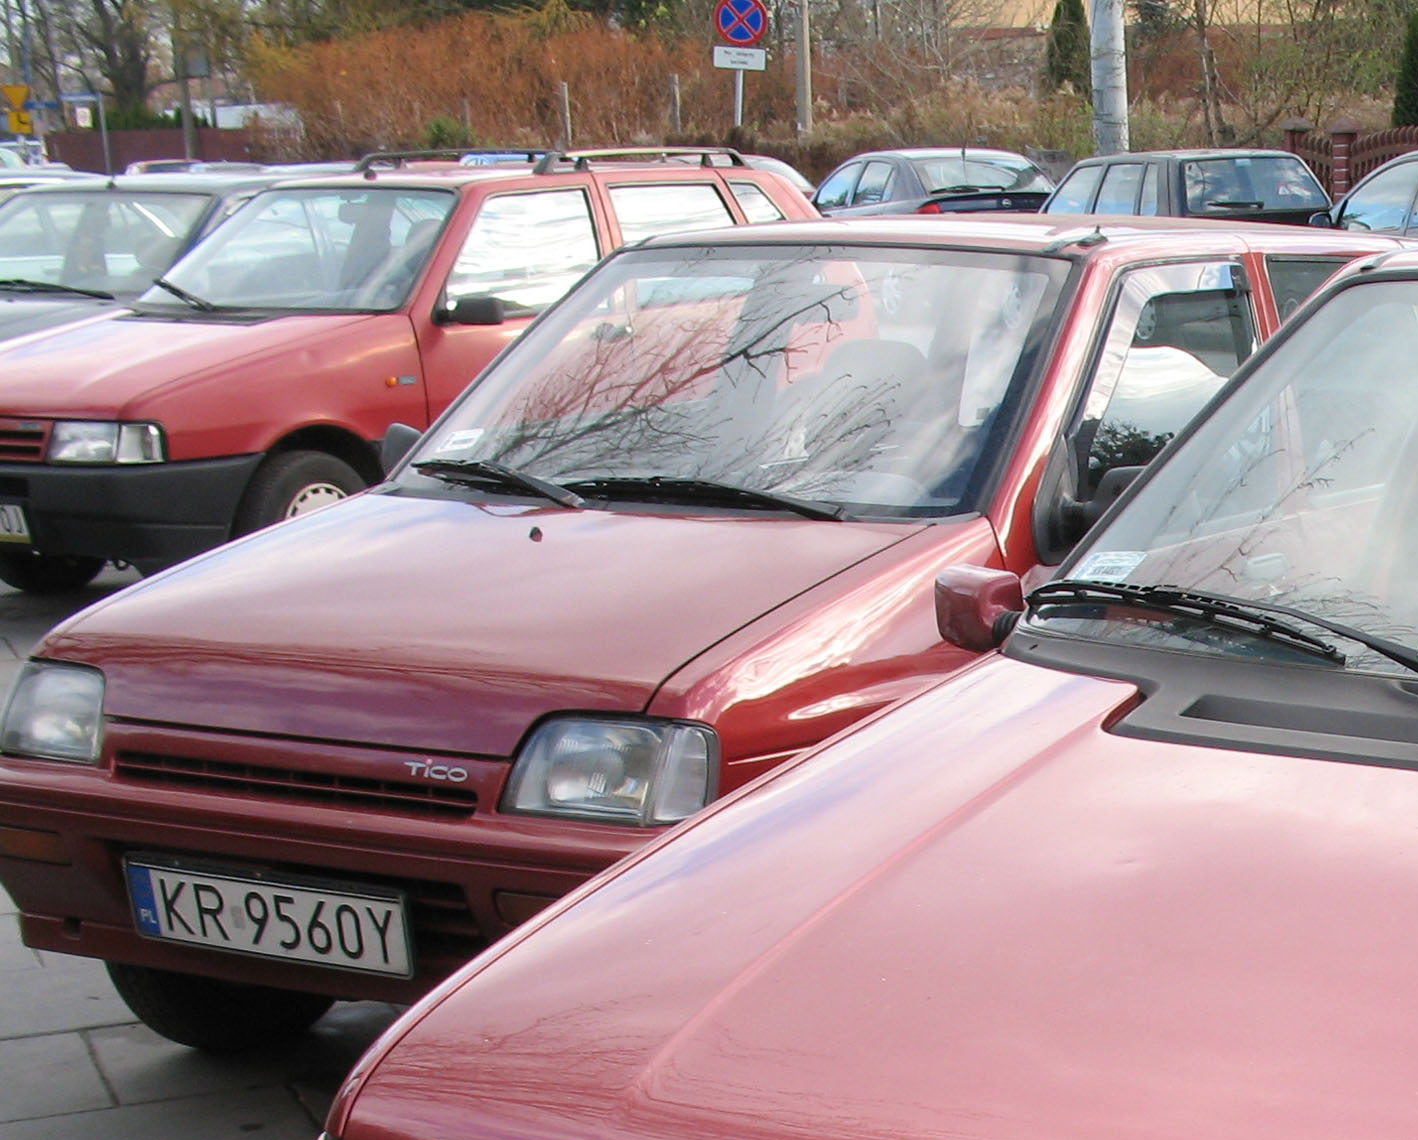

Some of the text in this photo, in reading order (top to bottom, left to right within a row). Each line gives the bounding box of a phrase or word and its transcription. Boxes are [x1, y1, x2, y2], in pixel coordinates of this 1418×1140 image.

[140, 908, 158, 924] PL
[160, 879, 393, 964] KR 9560Y
